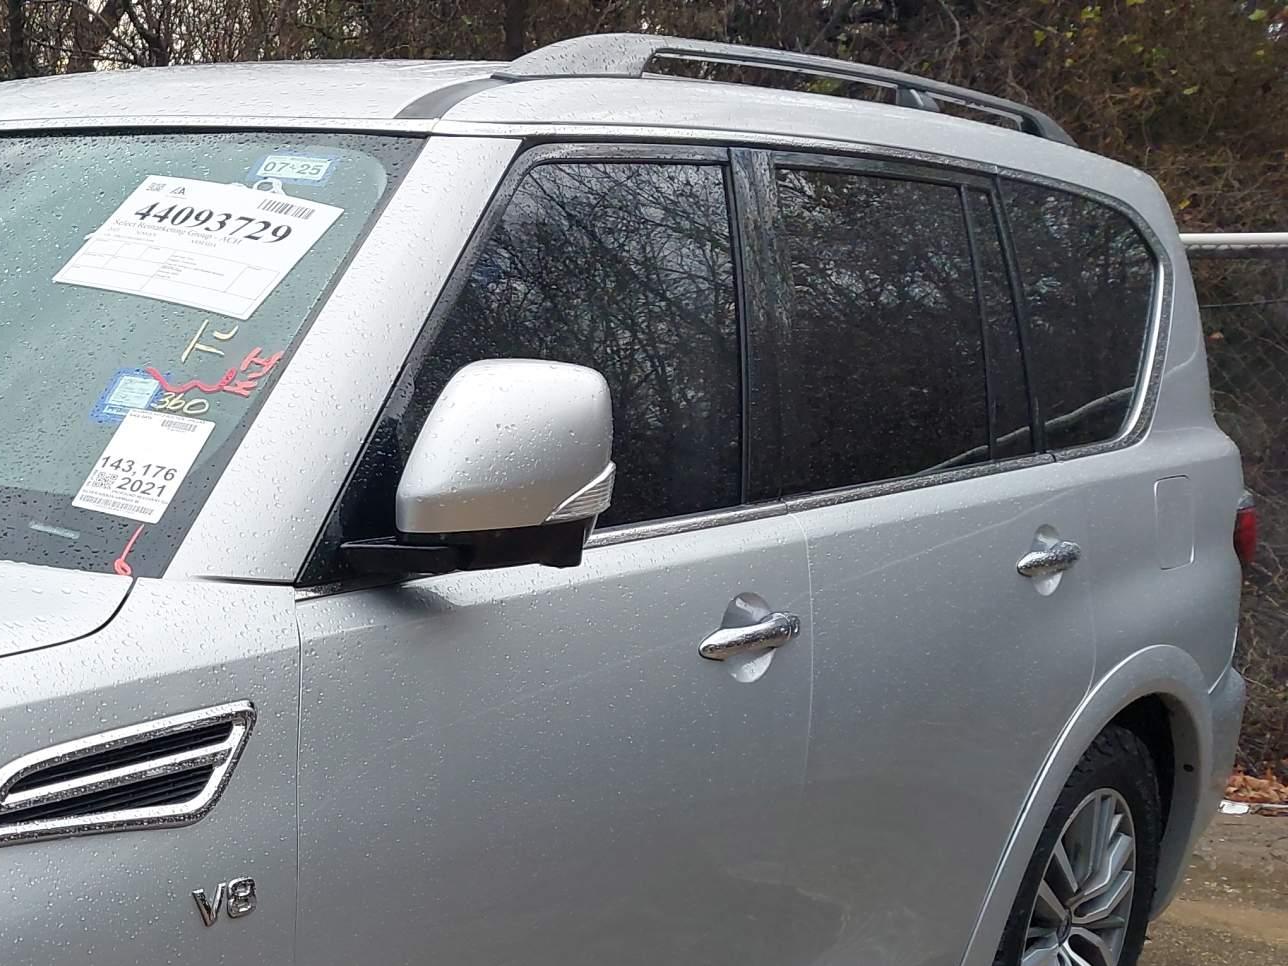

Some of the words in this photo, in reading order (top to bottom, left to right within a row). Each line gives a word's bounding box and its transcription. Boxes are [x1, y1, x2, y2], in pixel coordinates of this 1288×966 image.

[134, 201, 292, 244] 44093729
[152, 392, 210, 414] 360
[101, 455, 178, 481] 143,176
[115, 476, 167, 498] 2021
[192, 876, 257, 928] V8
